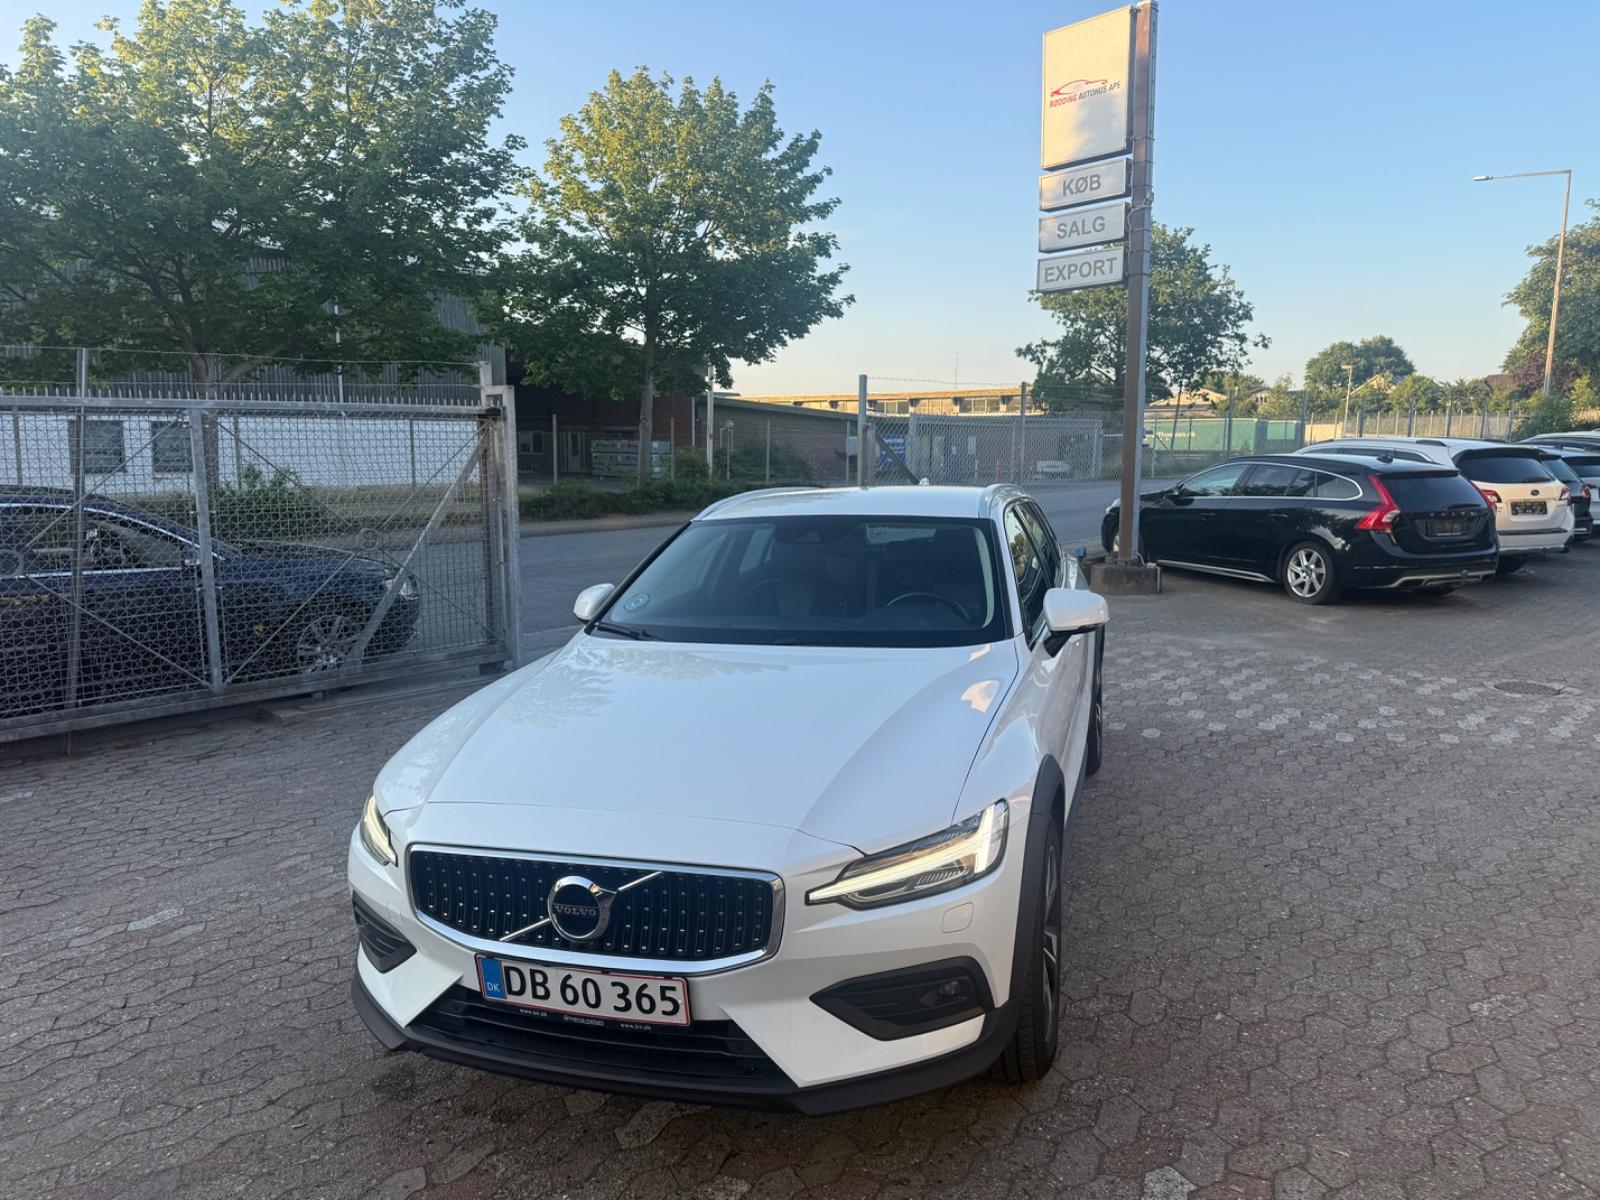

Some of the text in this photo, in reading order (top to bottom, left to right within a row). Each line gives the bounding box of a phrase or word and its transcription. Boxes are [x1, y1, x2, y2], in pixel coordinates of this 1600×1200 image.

[1079, 85, 1107, 100] AUTOHUS
[1062, 174, 1101, 196] KØB
[1057, 216, 1105, 239] SALG
[1044, 257, 1117, 283] EXPORT
[554, 905, 597, 916] VOLVO
[486, 981, 500, 992] DK
[504, 965, 680, 1016] DB 60 365
